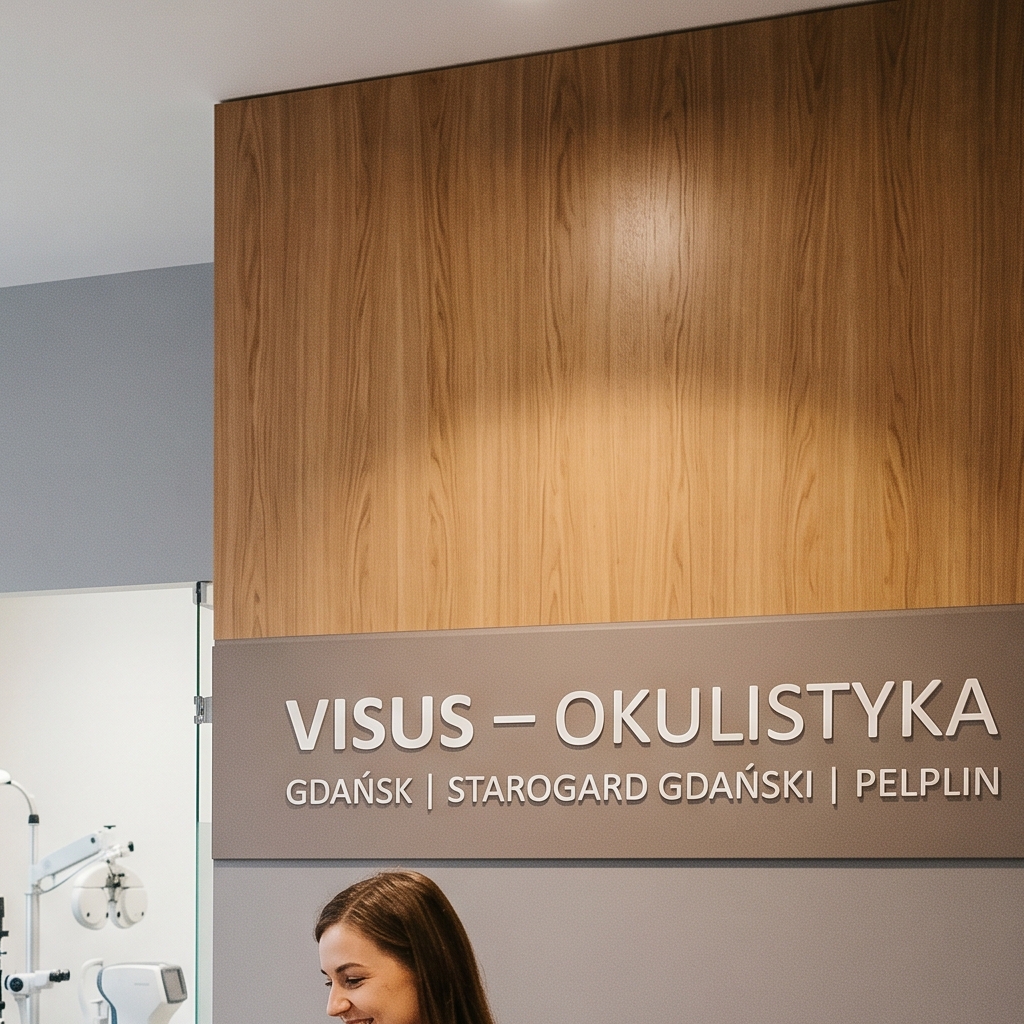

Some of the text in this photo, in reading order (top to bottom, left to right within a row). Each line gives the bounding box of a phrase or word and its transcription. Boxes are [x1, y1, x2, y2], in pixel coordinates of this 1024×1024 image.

[285, 694, 474, 751] VISUS
[555, 678, 999, 746] OKULISTYKA
[286, 771, 413, 806] GDAŃSK
[447, 773, 648, 804] STAROGARD
[658, 762, 814, 800] GDAŃSKI
[856, 766, 1000, 797] PELPLIN
